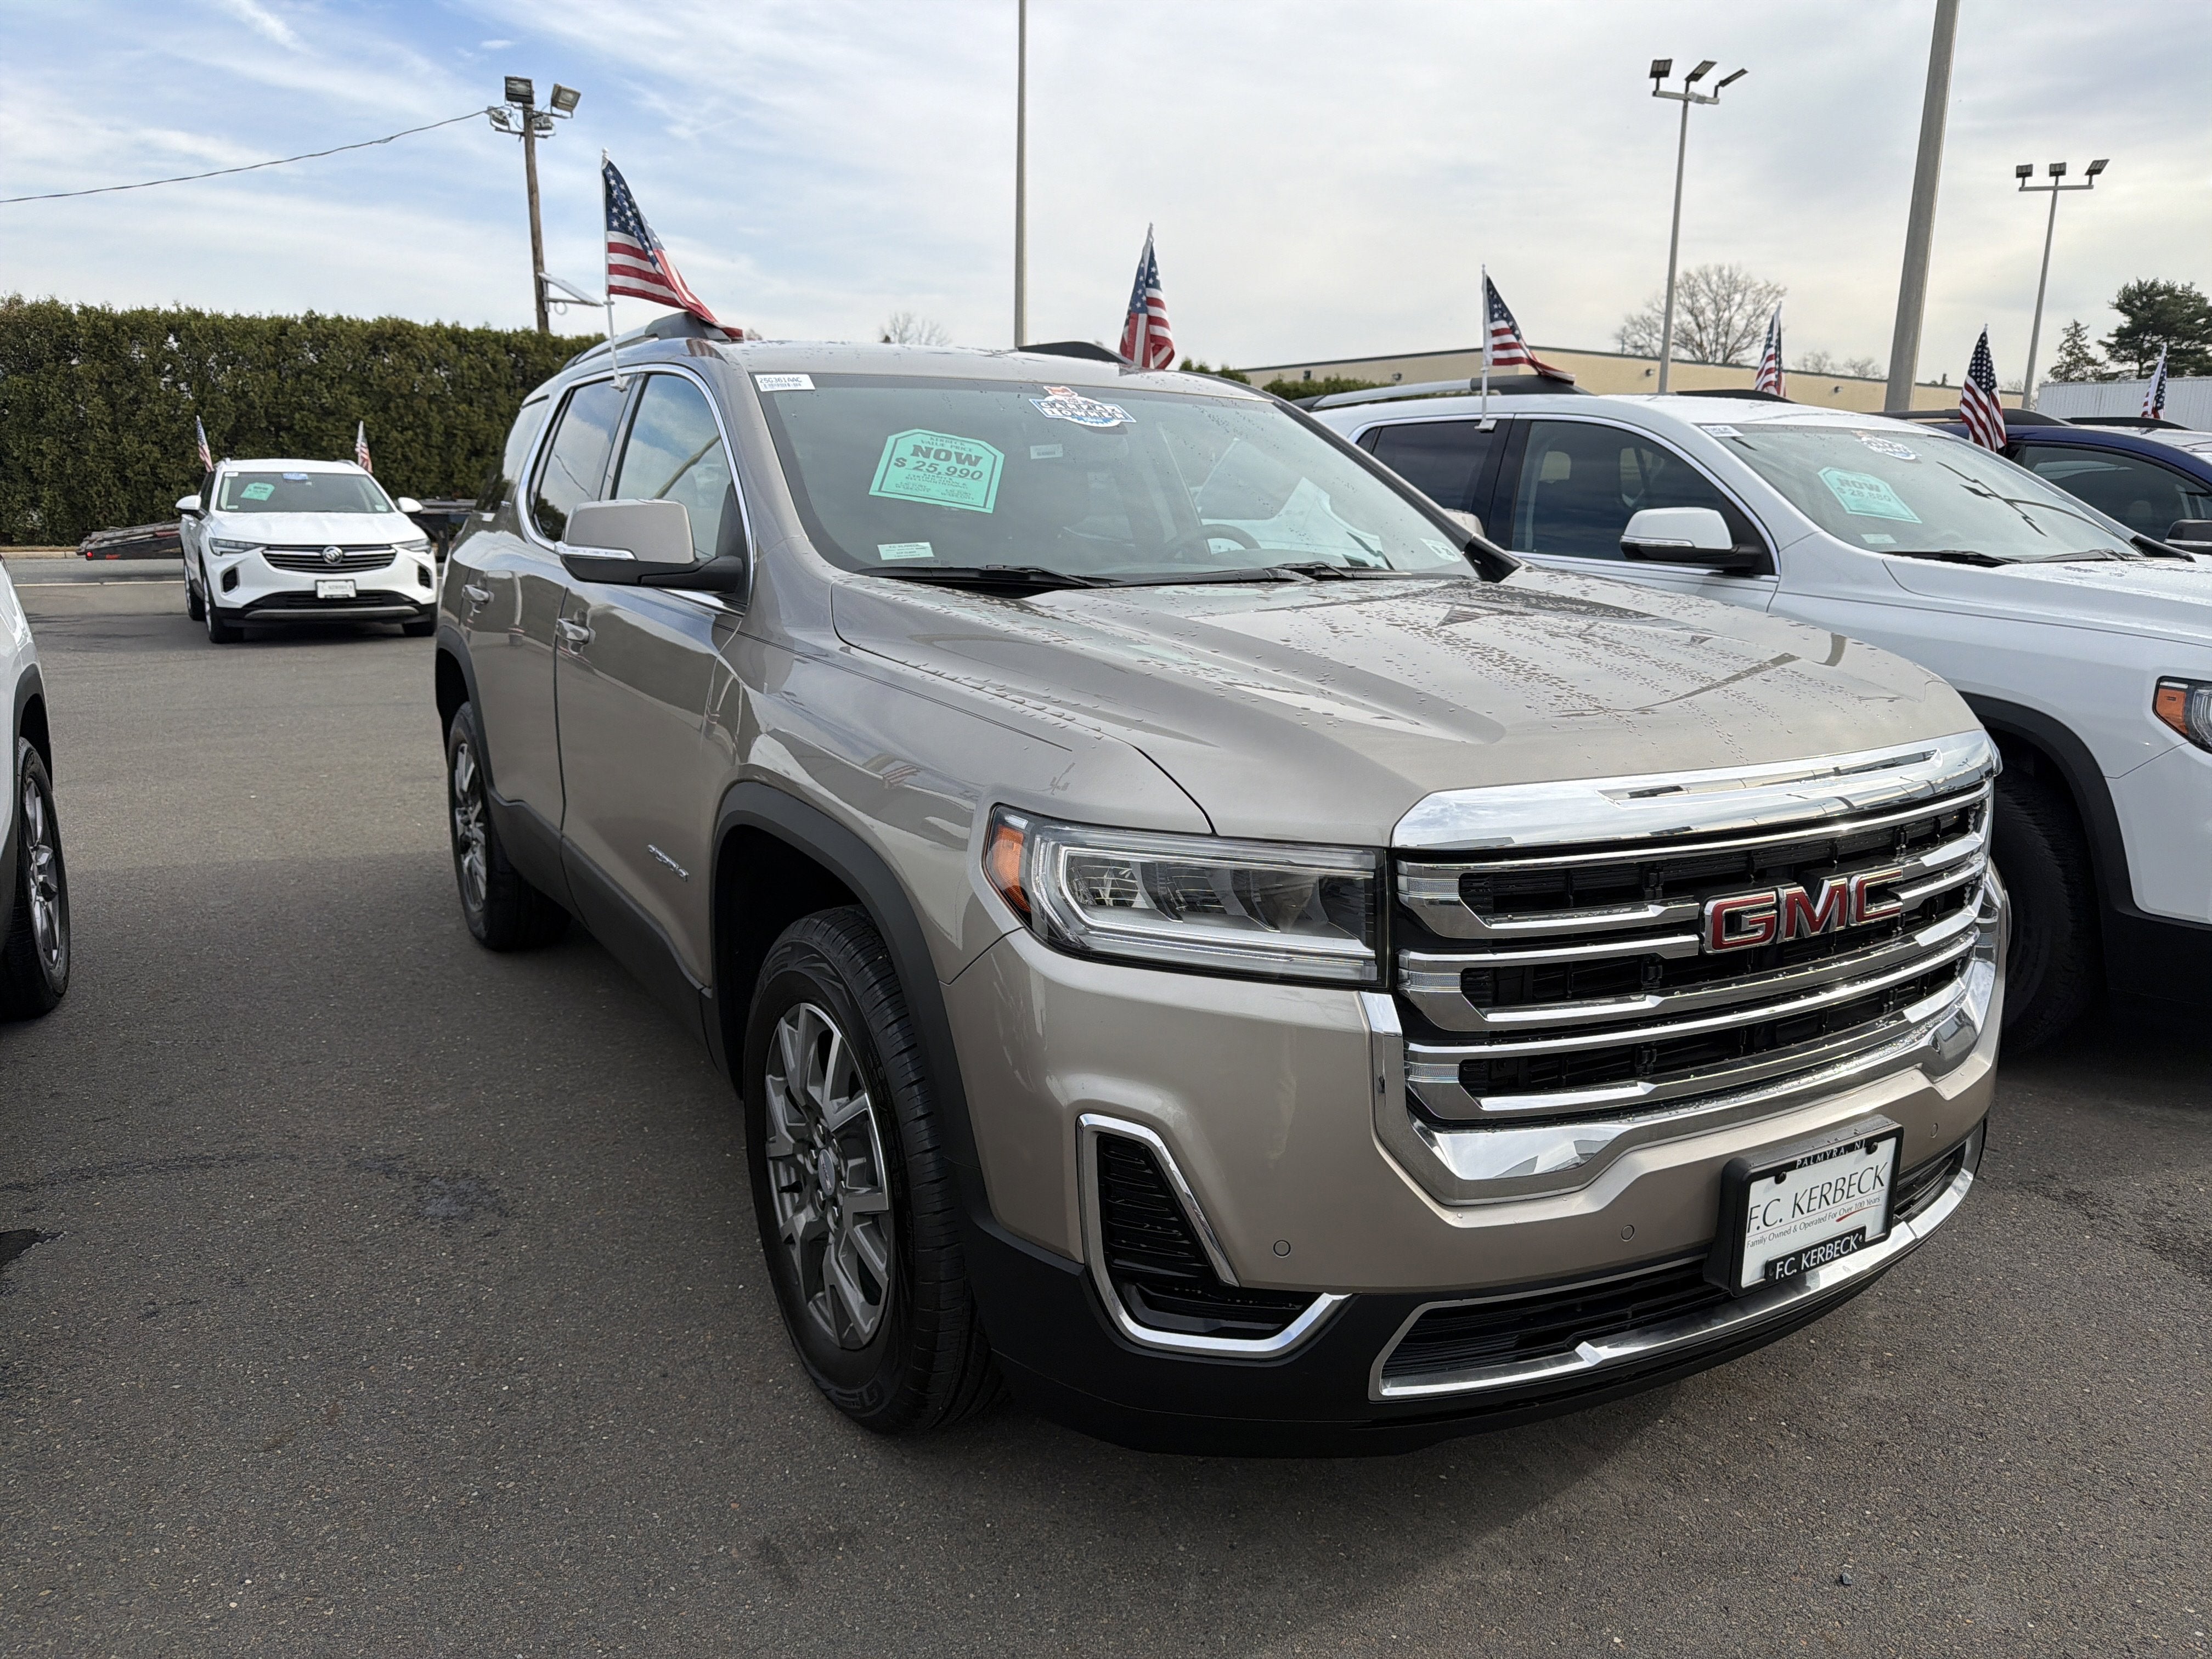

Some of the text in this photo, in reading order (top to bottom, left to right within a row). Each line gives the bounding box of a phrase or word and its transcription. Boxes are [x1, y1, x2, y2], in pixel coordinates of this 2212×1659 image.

[1061, 409, 1126, 420] OWNER
[921, 439, 945, 448] VALUE
[930, 437, 966, 447] KERBECK
[910, 444, 983, 467] NOW
[894, 457, 983, 481] $ 25,990
[1836, 478, 1881, 492] NOW
[1704, 868, 1905, 954] GMC
[1796, 1147, 1848, 1169] PALMYRA,
[1747, 1161, 1888, 1233] F.C. KERBECK
[1747, 1235, 1767, 1249] Family
[1768, 1228, 1792, 1242] Owned
[1799, 1215, 1827, 1231] Operated
[1828, 1211, 1838, 1221] For
[1839, 1205, 1853, 1216] Over
[1854, 1200, 1865, 1210] 100
[1866, 1197, 1881, 1206] Years
[1775, 1232, 1859, 1280] F.C. KERBECK
